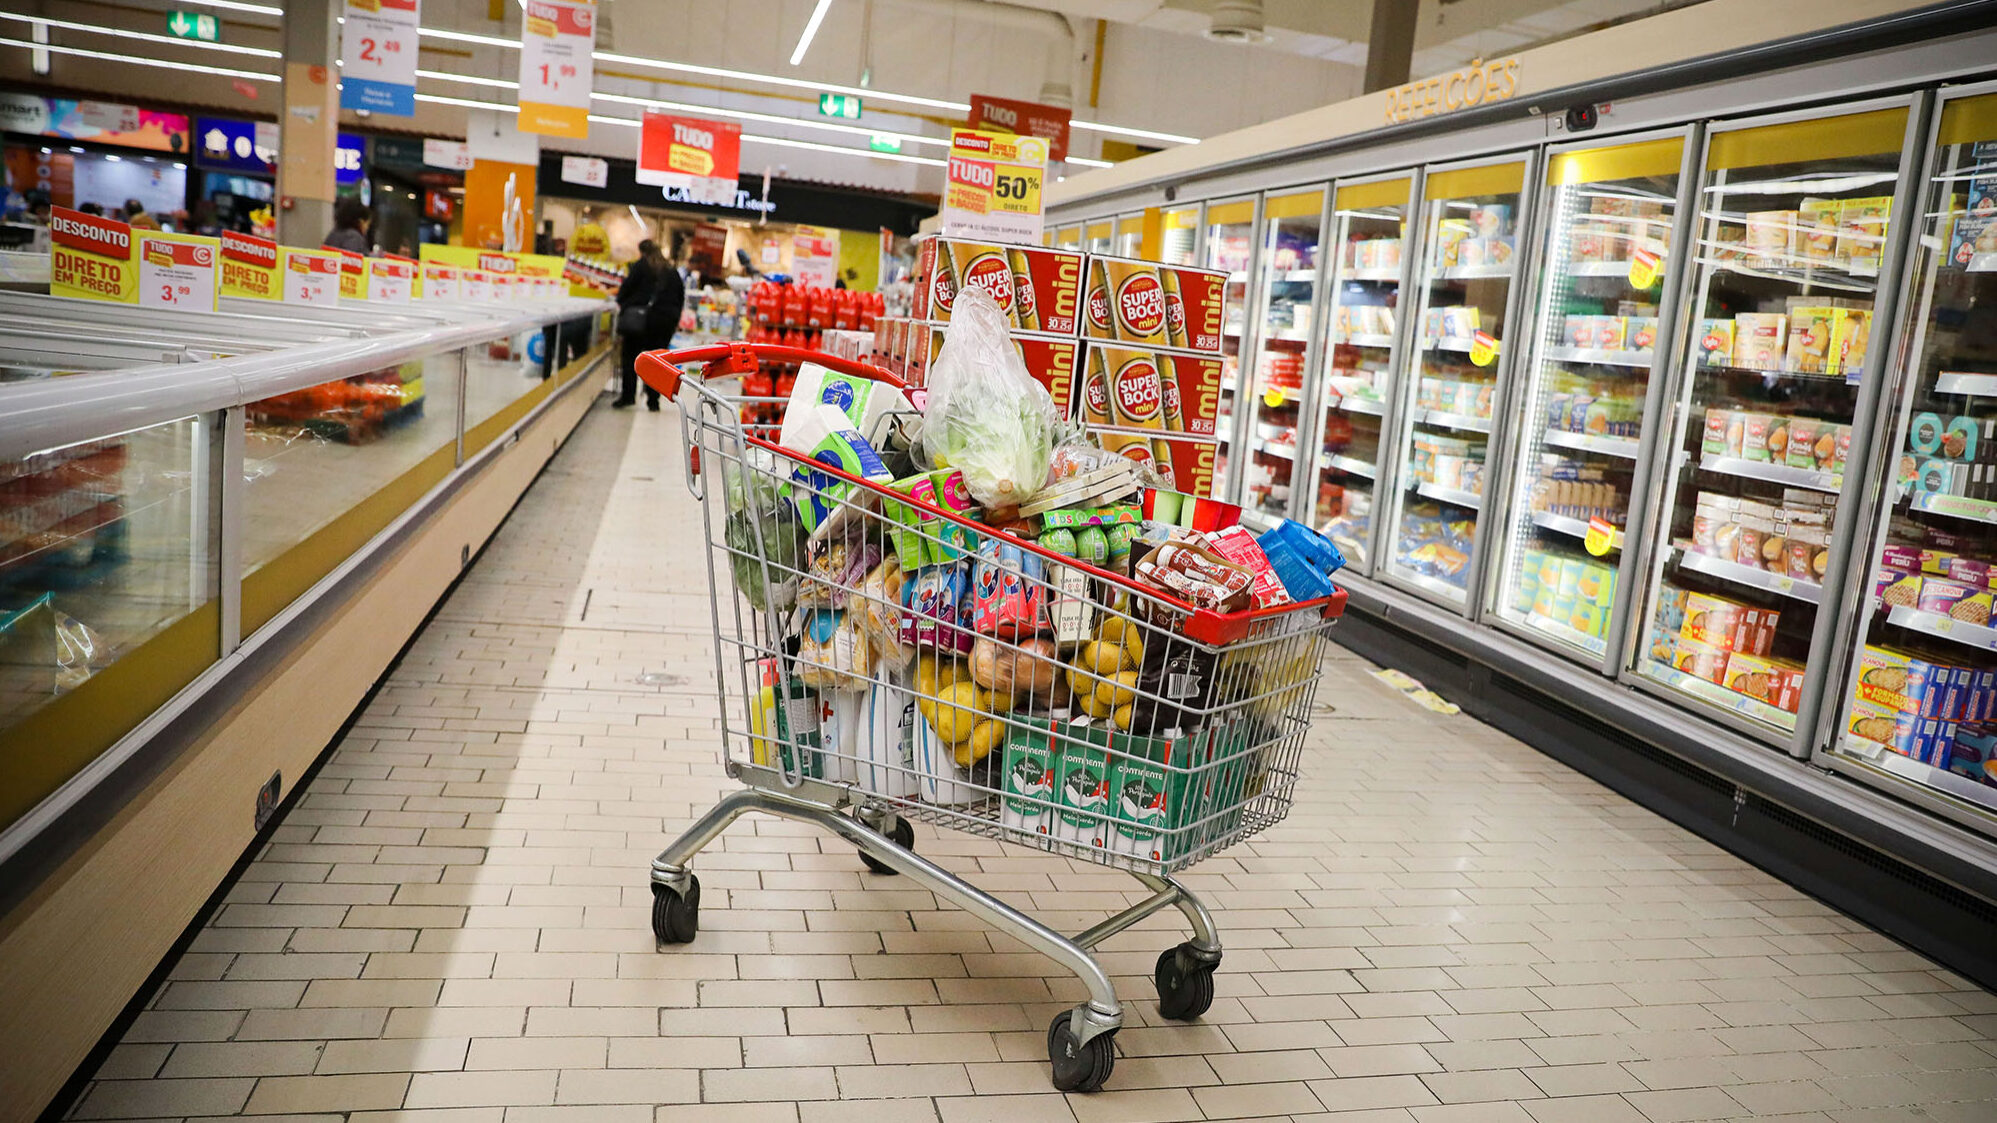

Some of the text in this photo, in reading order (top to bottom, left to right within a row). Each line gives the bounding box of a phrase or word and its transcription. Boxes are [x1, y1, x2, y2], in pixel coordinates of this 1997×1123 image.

[1384, 57, 1519, 125] REFEIÇÕES
[982, 103, 1017, 126] TUDO
[672, 123, 714, 150] TUDO
[950, 159, 1040, 200] TUDO 50%
[52, 216, 129, 248] DESCONTO
[149, 240, 174, 255] TUDO
[222, 236, 276, 260] DESCONTO
[55, 251, 121, 283] DIRETO
[223, 262, 270, 286] DIRETO
[969, 268, 1010, 289] SUPER
[54, 269, 121, 296] EM PREÇO
[984, 283, 1012, 300] OCK
[1051, 254, 1080, 317] mini
[1122, 287, 1162, 308] SUPER
[1200, 274, 1227, 335] mini
[1127, 301, 1163, 320] BOCK
[1047, 318, 1058, 330] 30
[1138, 316, 1158, 329] mini
[1195, 336, 1206, 348] 30
[1046, 343, 1074, 404] mini
[1120, 373, 1159, 394] SUPER
[1123, 386, 1160, 407] BOCK
[1196, 360, 1222, 419] mini
[1135, 401, 1154, 415] mini
[1191, 420, 1201, 432] 30
[1191, 443, 1216, 499] mini
